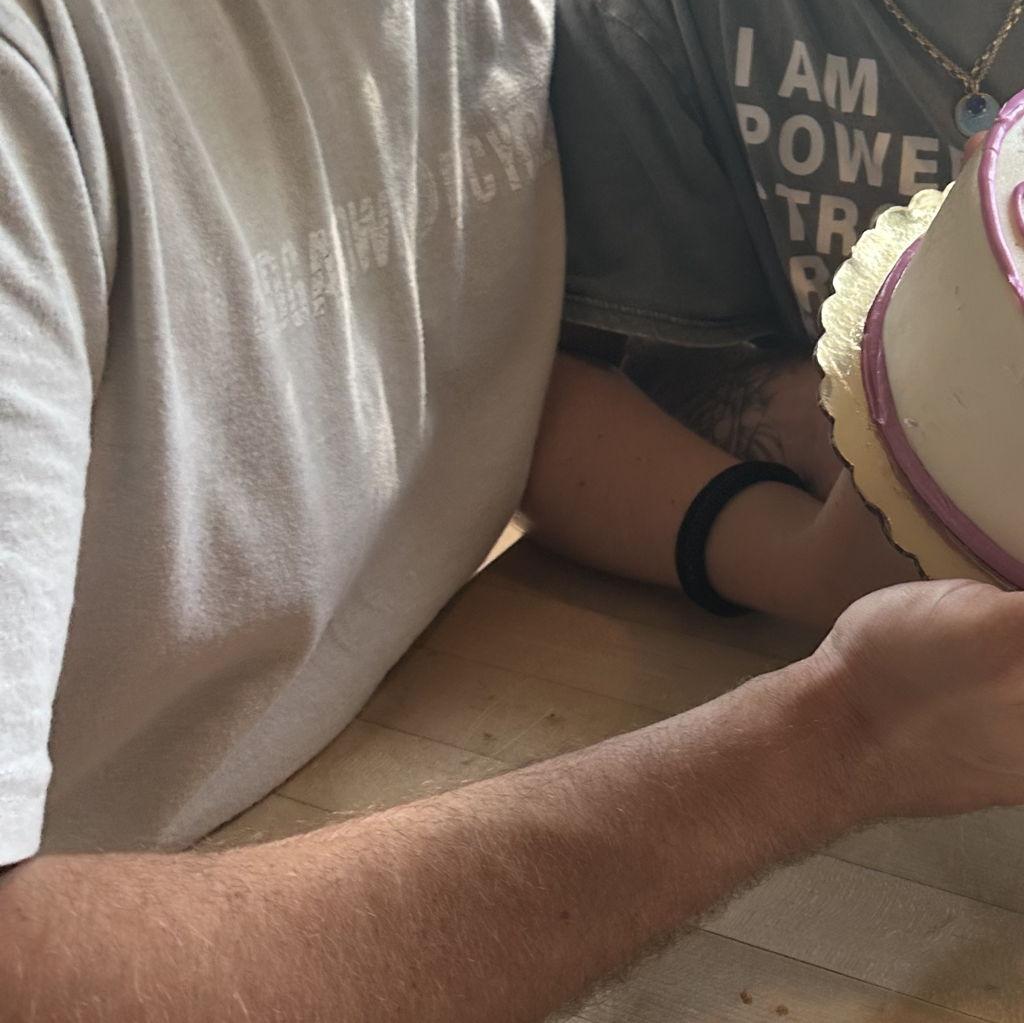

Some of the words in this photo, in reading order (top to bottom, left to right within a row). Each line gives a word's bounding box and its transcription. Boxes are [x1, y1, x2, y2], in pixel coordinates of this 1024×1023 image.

[734, 26, 755, 88] I
[777, 39, 879, 118] AM
[737, 102, 964, 196] POWE
